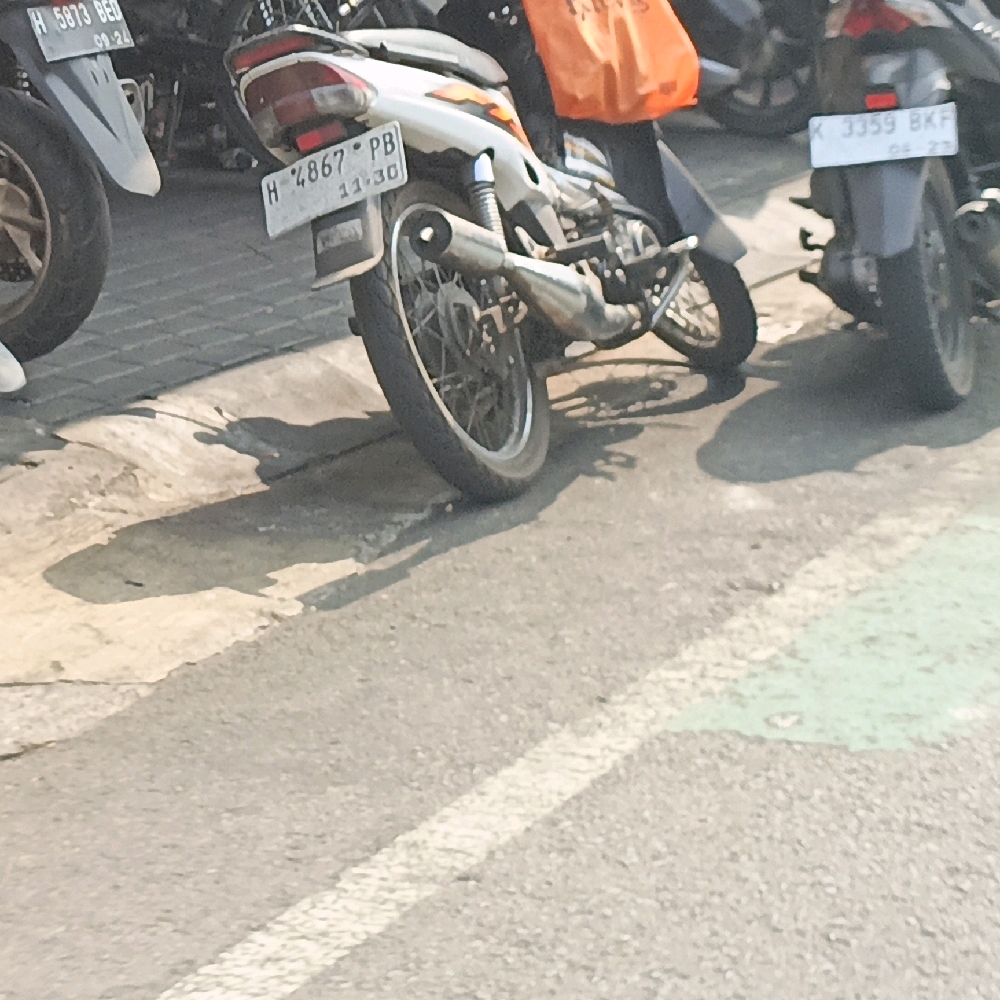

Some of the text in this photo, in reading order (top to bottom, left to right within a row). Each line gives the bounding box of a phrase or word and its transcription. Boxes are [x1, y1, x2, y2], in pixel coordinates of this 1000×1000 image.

[30, 10, 48, 35] H
[52, 2, 92, 30] 5873
[809, 121, 824, 142] K
[266, 131, 396, 206] H 4867 PB
